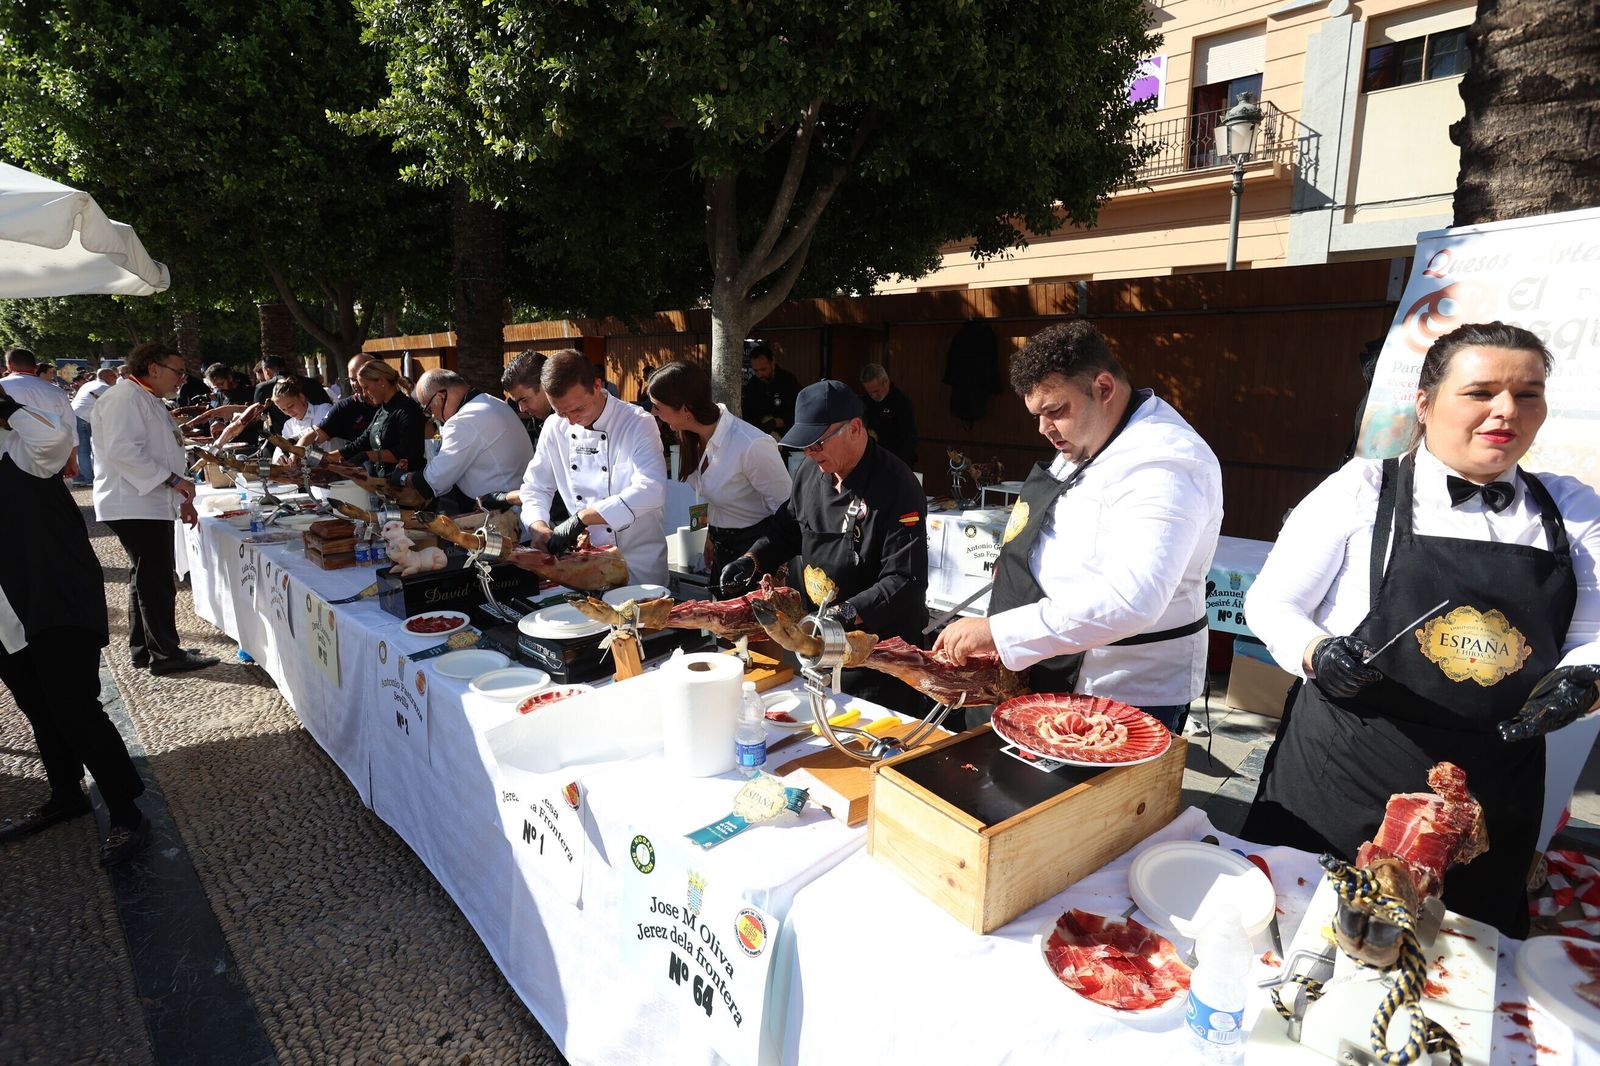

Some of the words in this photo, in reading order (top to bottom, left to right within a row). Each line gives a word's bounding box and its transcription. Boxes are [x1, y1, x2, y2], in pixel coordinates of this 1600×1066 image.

[1422, 248, 1511, 279] Quesos
[966, 543, 993, 554] Antonio
[424, 583, 470, 604] David
[1206, 599, 1231, 609] Desiré
[1209, 589, 1244, 598] Manuel
[1439, 632, 1510, 656] ESPAÑA
[539, 806, 574, 863] Frontera
[650, 896, 679, 919] Jose
[682, 907, 697, 932] M
[700, 924, 734, 980] Oliva
[637, 923, 668, 940] Jerez
[670, 925, 693, 956] dela
[696, 946, 743, 1028] frontera
[693, 974, 714, 1018] 64
